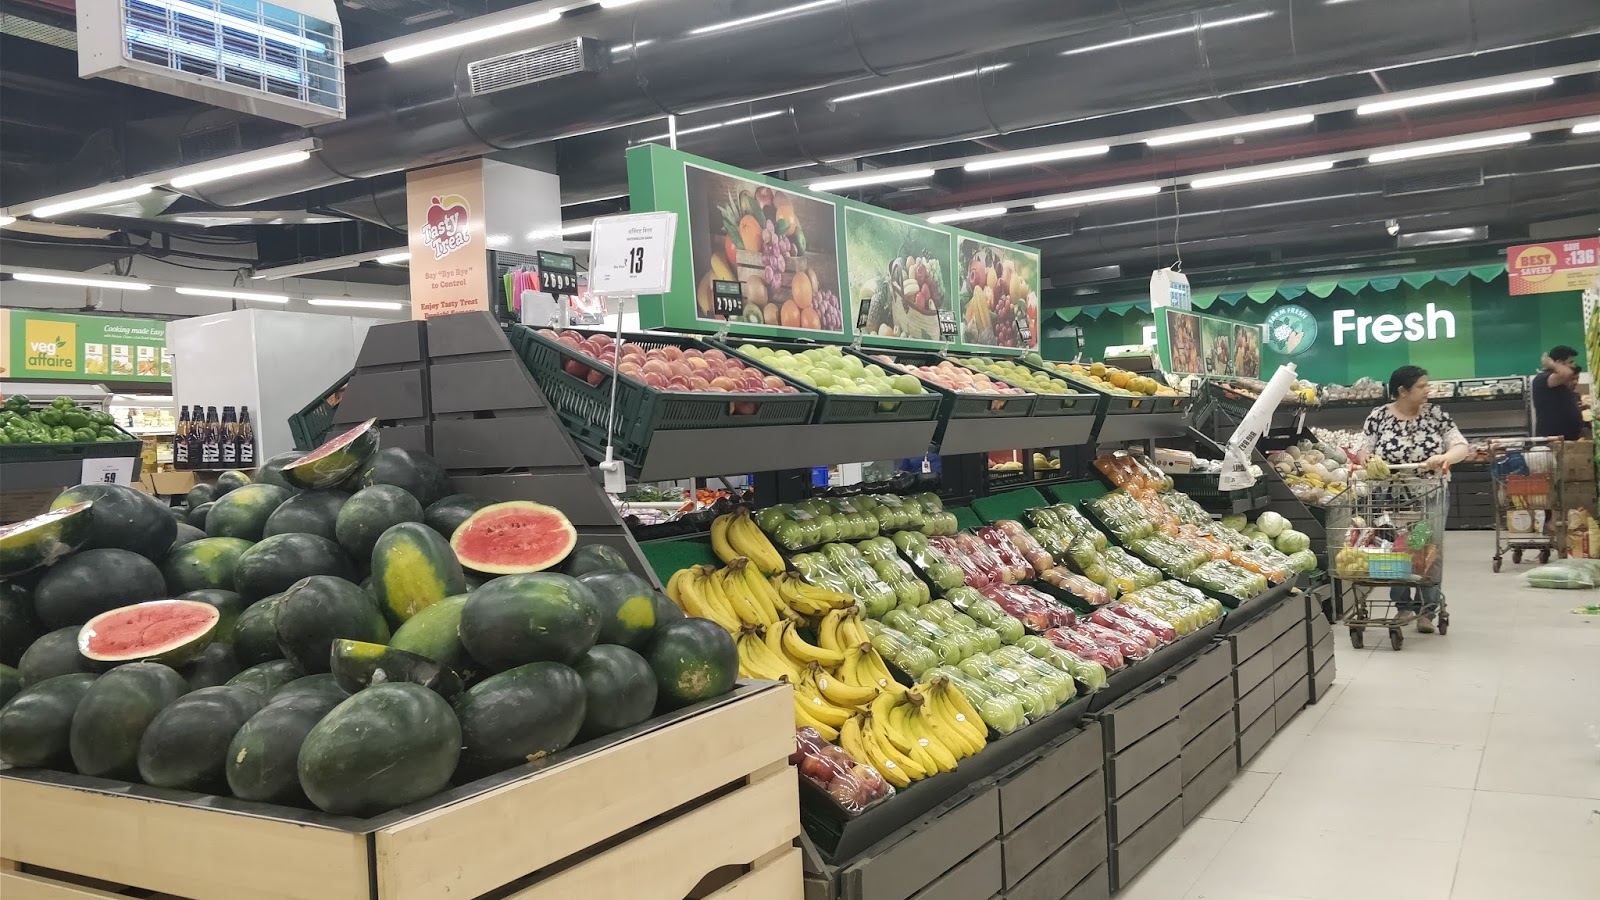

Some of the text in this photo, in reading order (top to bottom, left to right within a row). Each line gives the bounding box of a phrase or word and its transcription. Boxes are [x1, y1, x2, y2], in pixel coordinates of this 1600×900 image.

[421, 211, 460, 245] Tasty
[431, 225, 471, 259] Treat
[1563, 243, 1580, 252] SAVE
[1520, 254, 1551, 267] BEST
[1520, 266, 1552, 276] SAVERS
[440, 279, 467, 288] Control
[420, 298, 478, 311] Enjoy Tasty Treat
[1287, 307, 1308, 319] FRESH
[103, 324, 130, 335] Cooking
[150, 327, 165, 337] Easy
[1332, 302, 1456, 346] Fresh
[30, 340, 57, 356] veg
[28, 352, 73, 368] affaire
[1246, 430, 1257, 444] BIG
[177, 443, 189, 463] FIZZ
[208, 443, 220, 463] FIZZ
[223, 443, 236, 463] FIZZ
[241, 443, 253, 463] FIZZ
